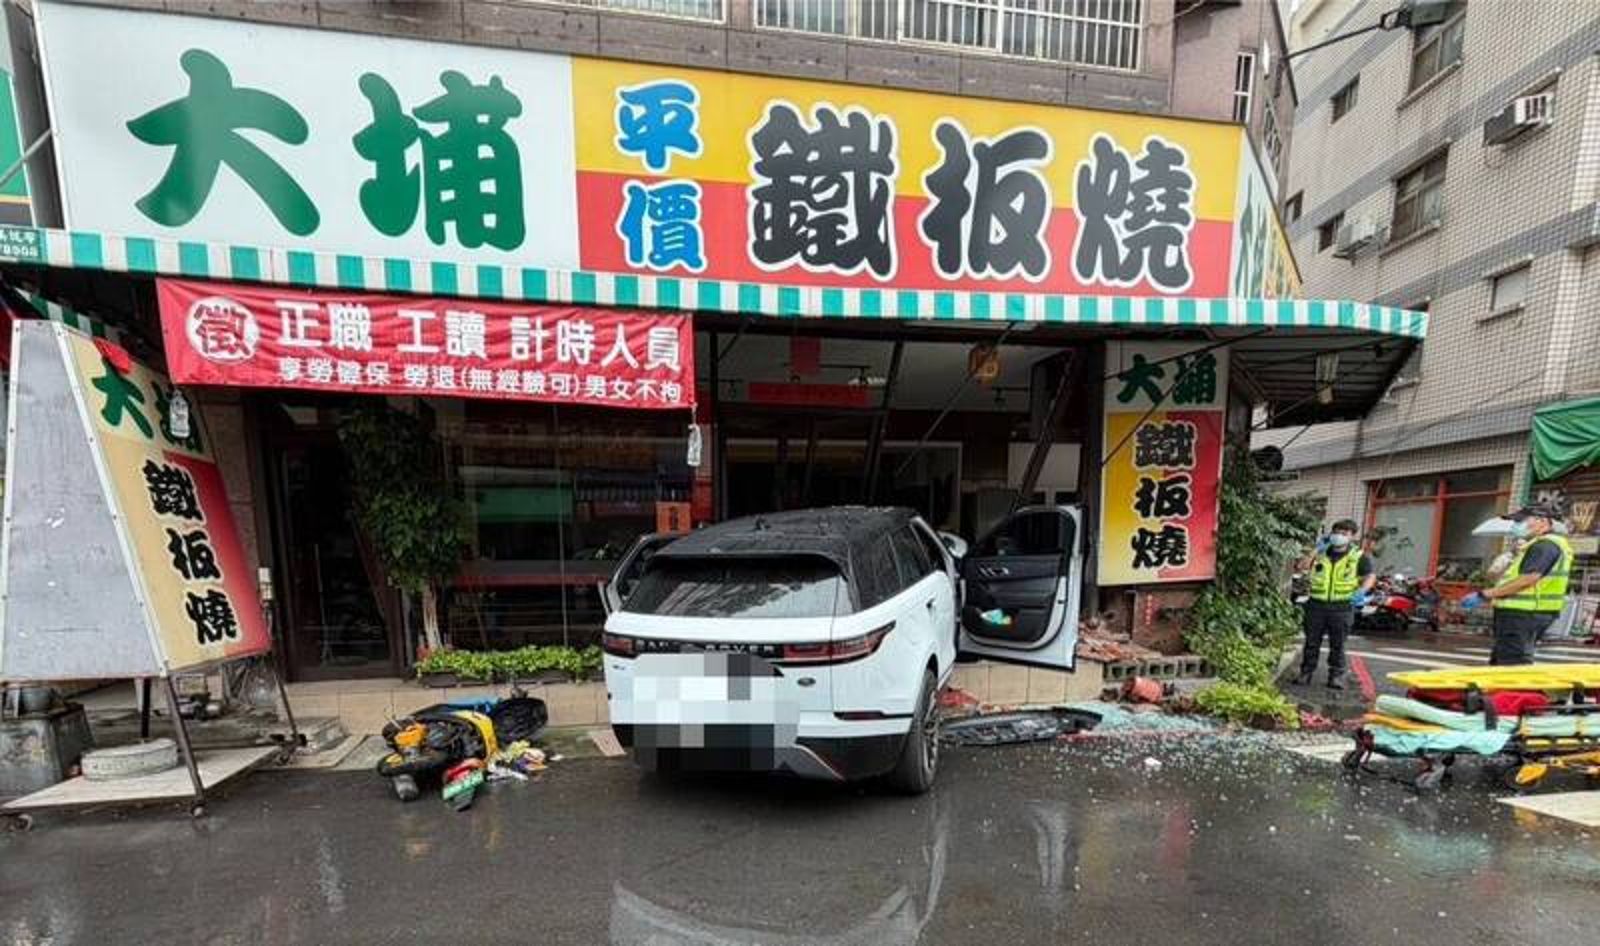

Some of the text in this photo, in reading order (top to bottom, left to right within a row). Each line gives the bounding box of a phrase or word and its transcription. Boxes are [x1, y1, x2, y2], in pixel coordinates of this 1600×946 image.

[128, 48, 526, 251] 大埔
[617, 83, 704, 269] 平價
[751, 104, 1193, 288] 鐵板燒
[275, 300, 681, 372] 正職 工讀 計時人員
[1117, 353, 1217, 405] 大埔
[142, 458, 237, 645] 鐵板燒
[1131, 422, 1195, 570] 鐵板燒
